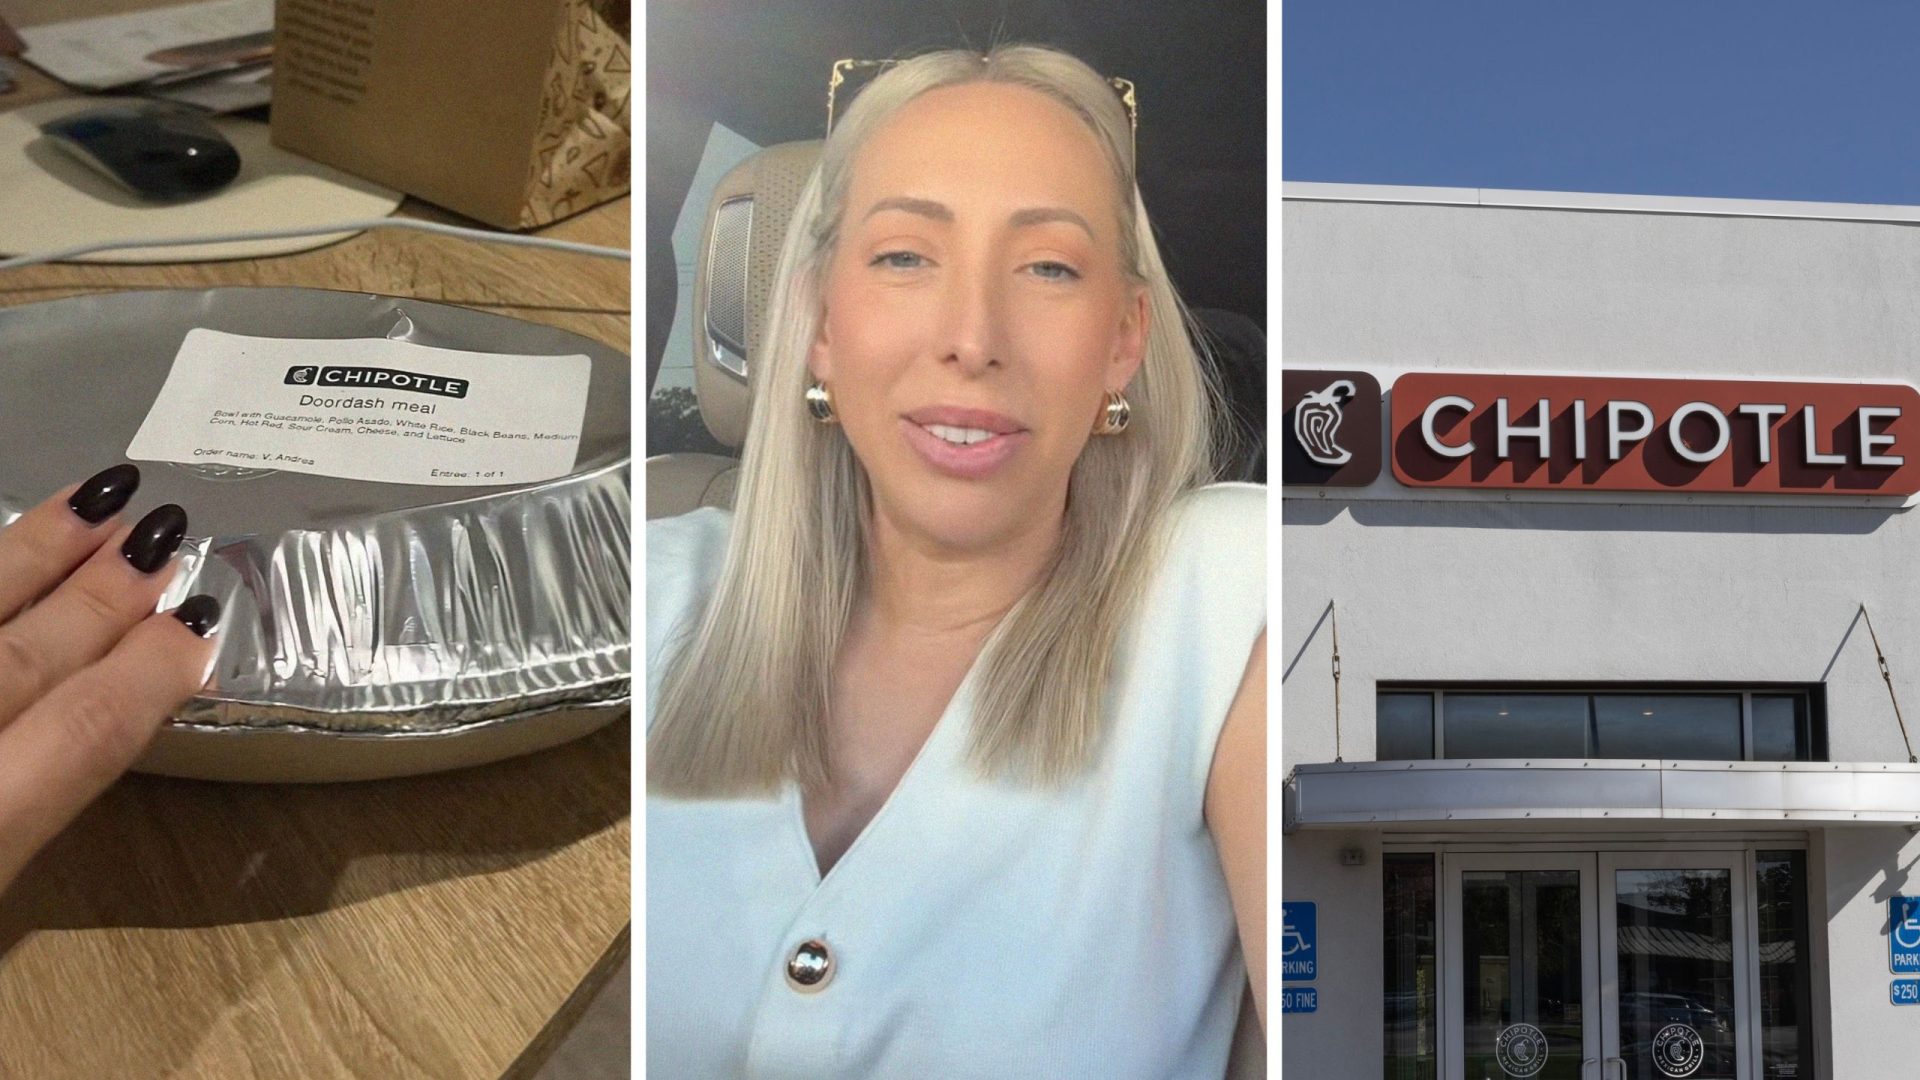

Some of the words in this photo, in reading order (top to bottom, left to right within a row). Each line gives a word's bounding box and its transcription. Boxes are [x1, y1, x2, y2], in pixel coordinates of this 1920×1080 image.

[325, 369, 462, 394] CHIPOTLE
[299, 394, 385, 409] Doordash
[391, 401, 436, 415] meal
[209, 417, 236, 427] Corn,
[240, 419, 259, 427] Hot
[287, 423, 313, 432] Sour
[315, 424, 353, 435] Cream,
[356, 426, 399, 437] Cheese,
[403, 430, 424, 439] and
[426, 432, 466, 444] Lettuce
[213, 410, 239, 418] Bowl
[264, 412, 325, 424] Guacamole,
[328, 416, 354, 425] Pollo
[356, 417, 393, 427] Asado,
[396, 419, 427, 430] White
[429, 422, 456, 434] Rice,
[459, 427, 490, 438] Black
[493, 431, 530, 441] Beans,
[533, 432, 578, 441] Medium
[1421, 395, 1905, 467] CHIPOTLE
[193, 448, 224, 456] Order
[226, 450, 258, 460] name:
[275, 453, 315, 466] Andrea
[1296, 992, 1316, 1008] FINE
[1893, 984, 1918, 999] $250
[1500, 1026, 1544, 1047] CHIPOTLE
[1656, 1026, 1700, 1047] CHIPOTLE
[1658, 1055, 1684, 1073] MEXICAN
[1684, 1054, 1699, 1071] GRILL
